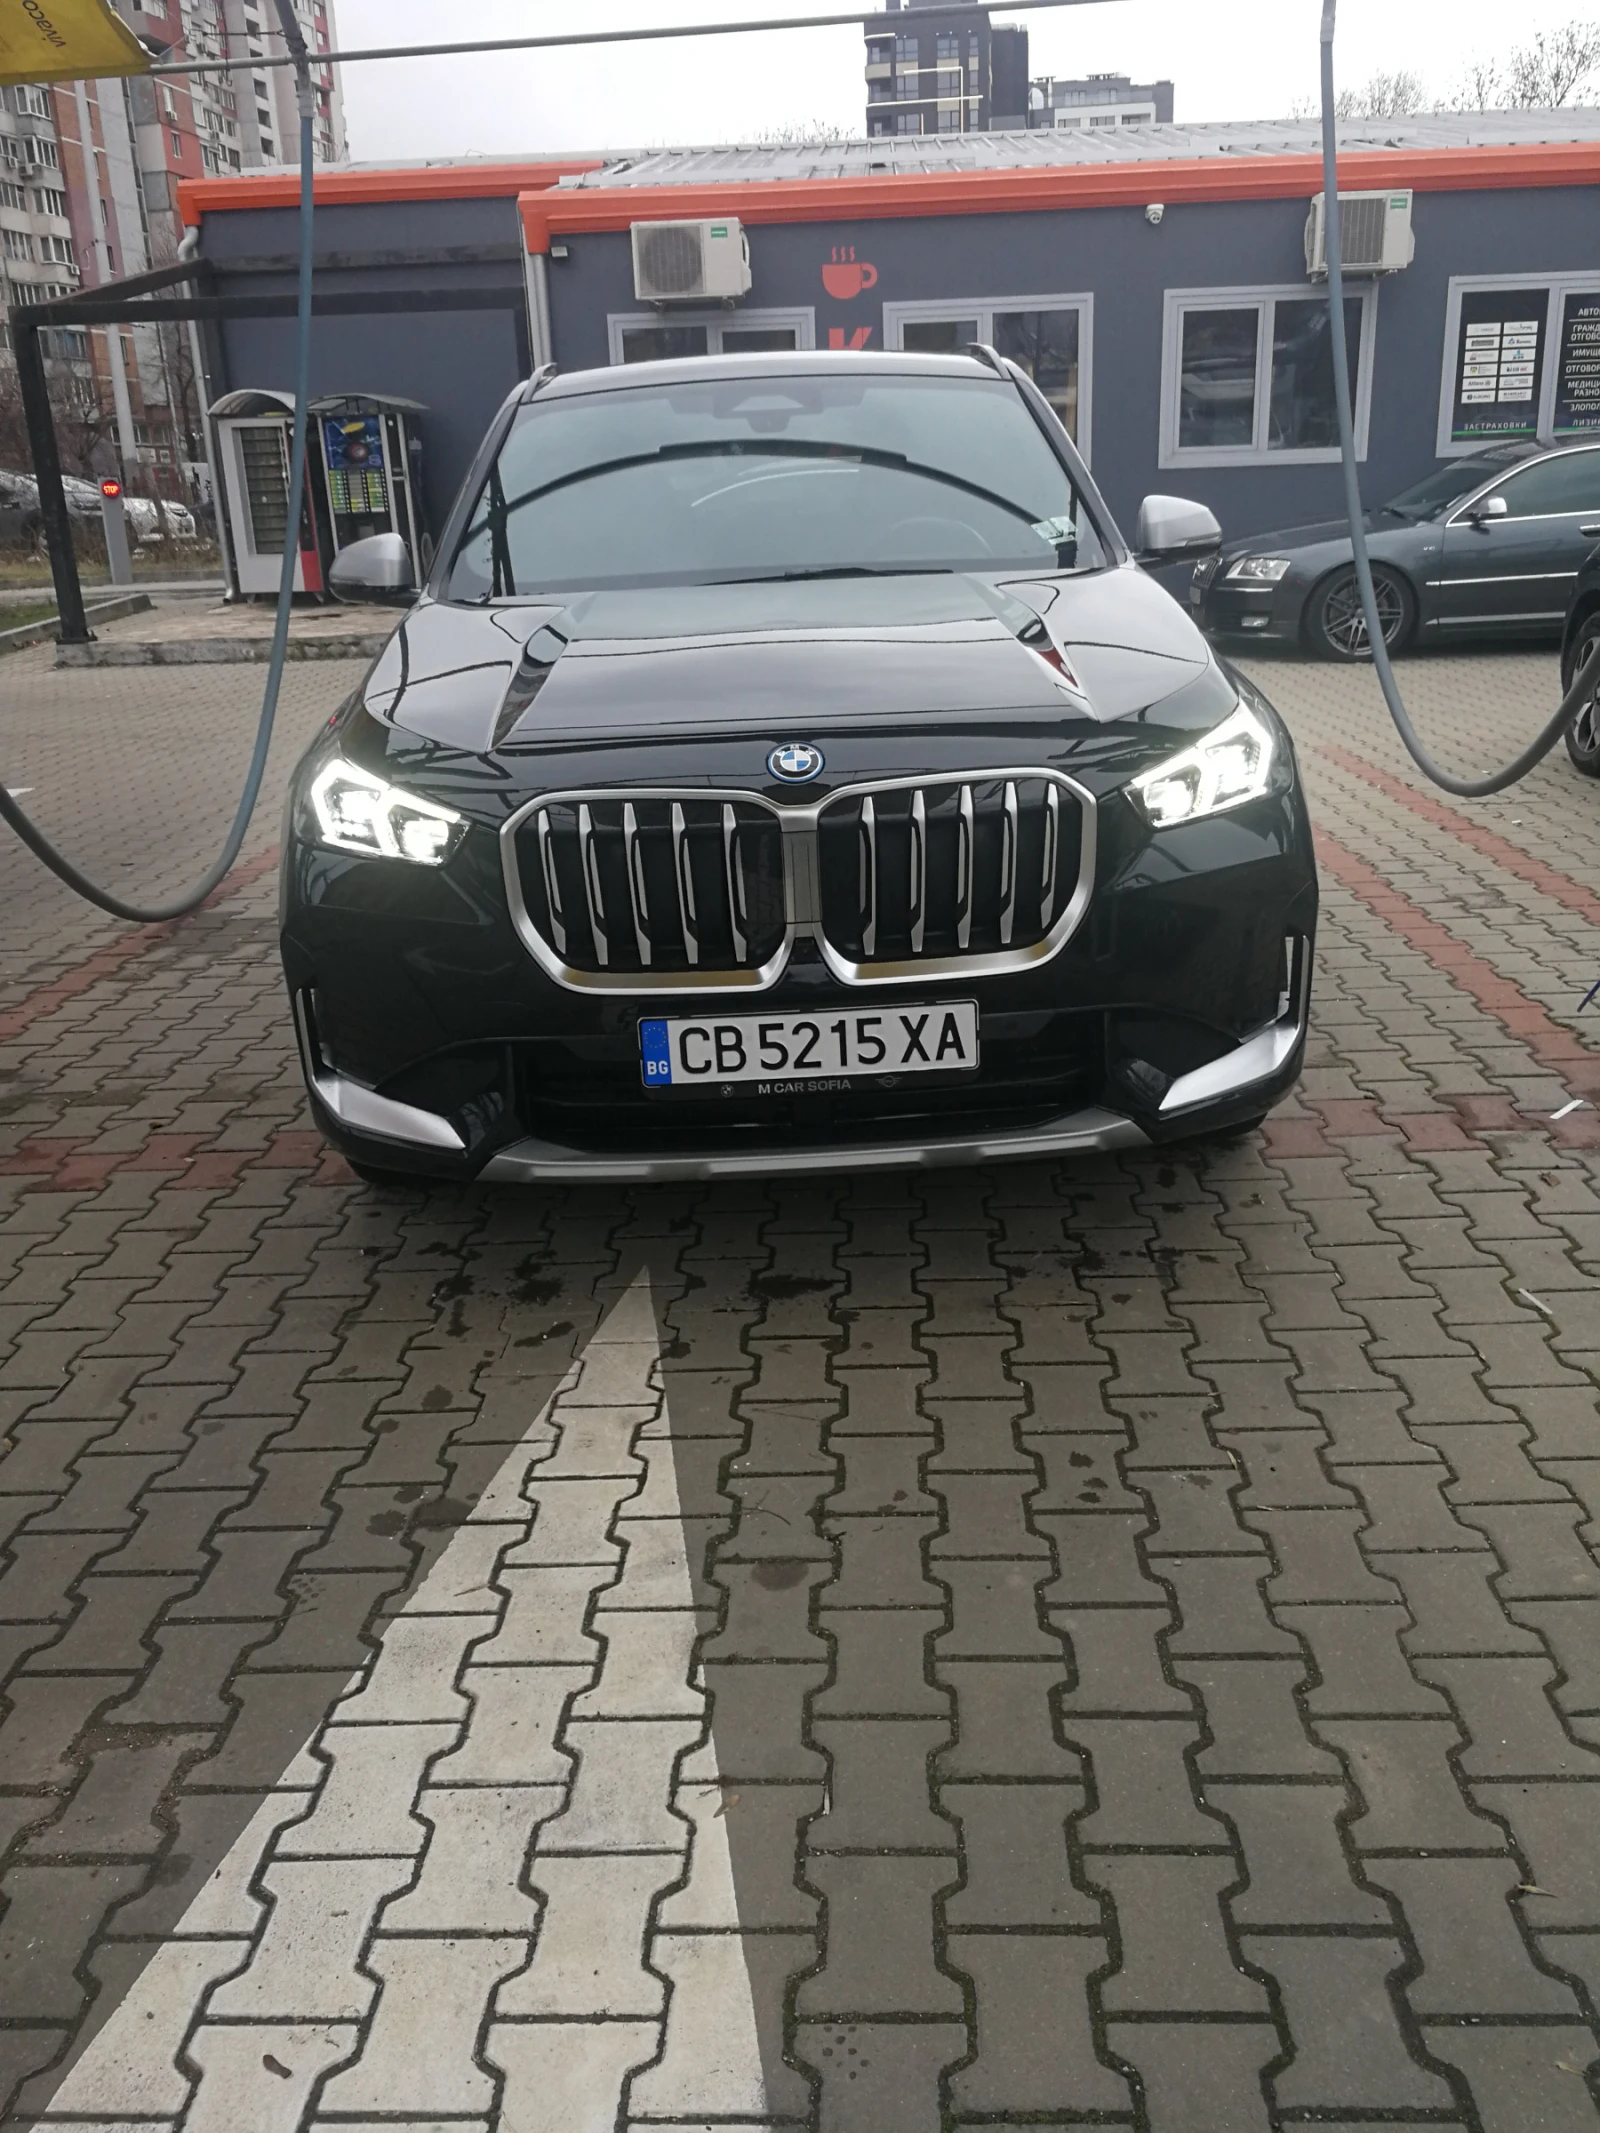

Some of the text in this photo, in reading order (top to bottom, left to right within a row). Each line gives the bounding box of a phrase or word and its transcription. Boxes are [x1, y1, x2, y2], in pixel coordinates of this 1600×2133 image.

[1578, 308, 1600, 316] АВТО
[1464, 422, 1527, 431] ЗАСТРАХОВКИ
[103, 485, 118, 494] STOP
[679, 1012, 967, 1074] CB 5215 XA
[647, 1060, 669, 1075] BG
[758, 1079, 852, 1095] M CAR SOFIA
